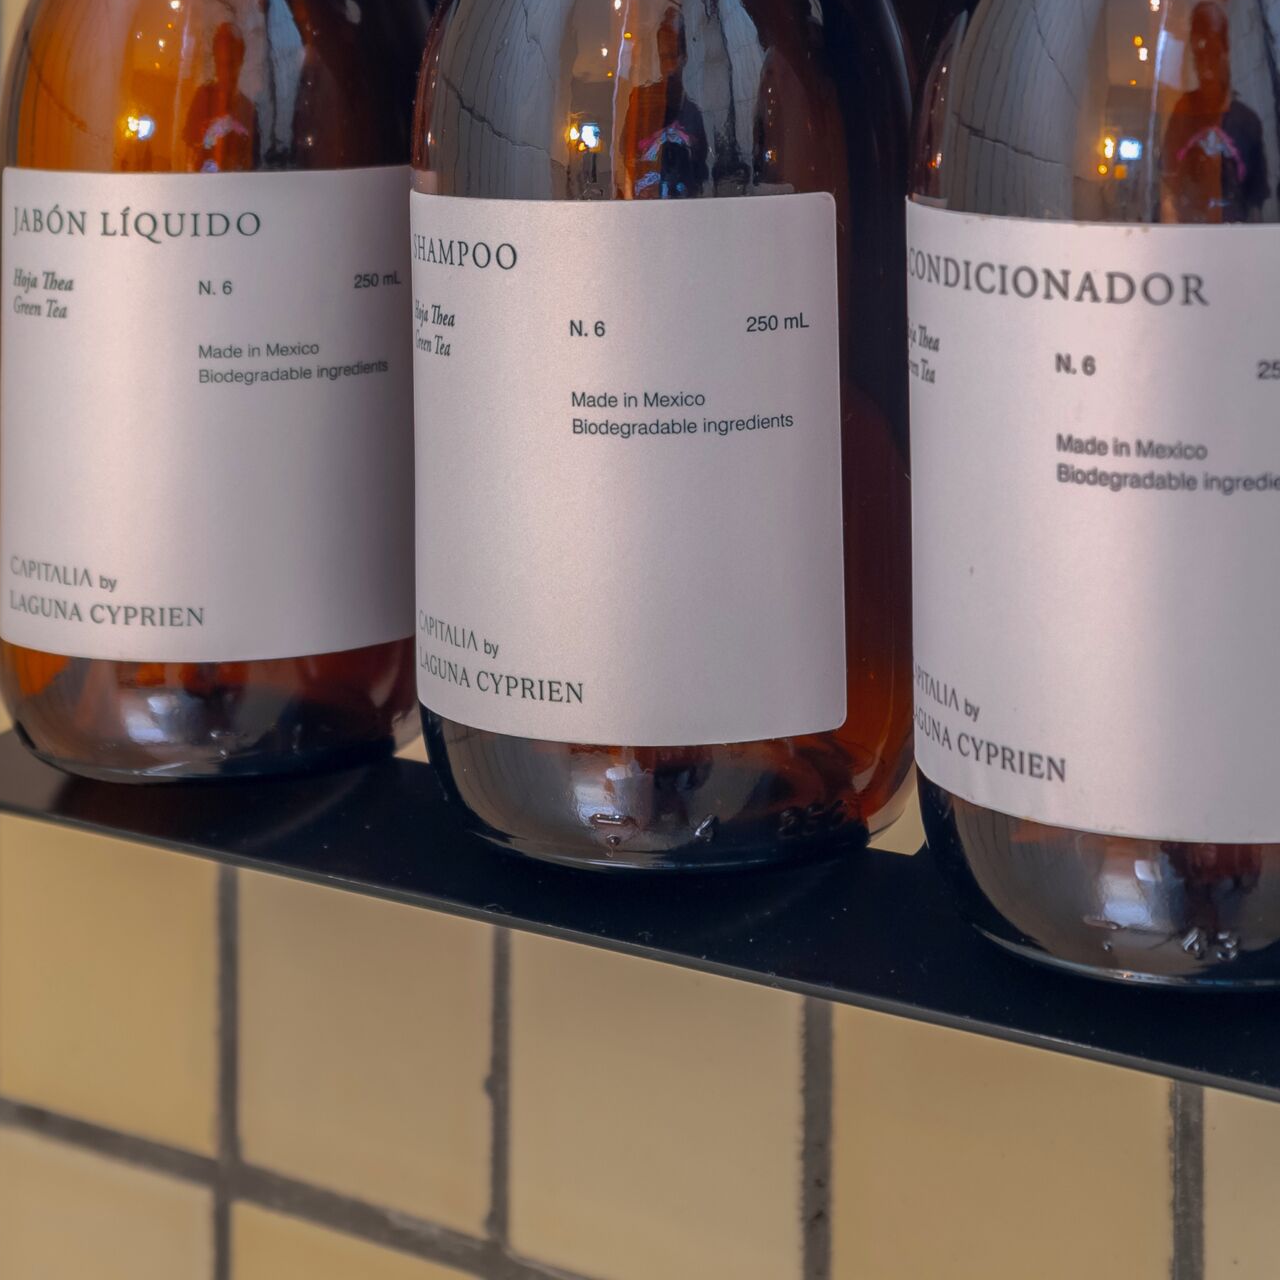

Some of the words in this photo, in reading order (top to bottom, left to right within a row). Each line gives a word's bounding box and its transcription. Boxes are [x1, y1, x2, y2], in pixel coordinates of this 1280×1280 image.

[13, 204, 88, 237] JABÓN
[100, 206, 261, 244] LÍQUIDO
[413, 233, 518, 270] SHAMPOO
[12, 269, 38, 291] Hoja
[42, 270, 75, 292] Thea
[198, 280, 216, 296] N.
[221, 280, 233, 296] 6
[353, 273, 379, 289] 250
[382, 270, 402, 287] mL
[908, 246, 1210, 306] CONDICIONADOR
[12, 296, 42, 318] Green
[45, 299, 68, 319] Tea
[431, 304, 455, 327] Thea
[569, 320, 588, 338] N.
[594, 321, 606, 338] 6
[745, 315, 779, 333] 250
[784, 312, 810, 330] mL
[198, 343, 243, 360] Made
[248, 342, 261, 359] in
[265, 341, 320, 358] Mexico
[434, 334, 451, 357] Tea
[918, 324, 940, 352] Thea
[198, 365, 312, 386] Biodegradable
[316, 358, 389, 382] ingredients
[920, 358, 936, 384] Tea
[1055, 353, 1077, 374] N.
[1082, 356, 1096, 376] 6
[571, 391, 619, 408] Made
[623, 391, 639, 408] in
[643, 390, 706, 408] Mexico
[572, 418, 698, 439] Biodegradable
[703, 412, 795, 437] ingredients
[1056, 433, 1108, 457] Made
[1113, 438, 1131, 458] in
[1135, 440, 1208, 461] Mexico
[1056, 463, 1198, 492] Biodegradable
[9, 554, 94, 589] CAPITALIA
[99, 575, 118, 593] by
[9, 589, 83, 622] LAGUNA
[90, 603, 206, 628] CYPRIEN
[419, 608, 478, 652] CAPITALIA
[483, 638, 499, 659] by
[419, 646, 471, 689] LAGUNA
[476, 669, 585, 705] CYPRIEN
[964, 697, 981, 723] by
[957, 731, 1067, 783] CYPRIEN
